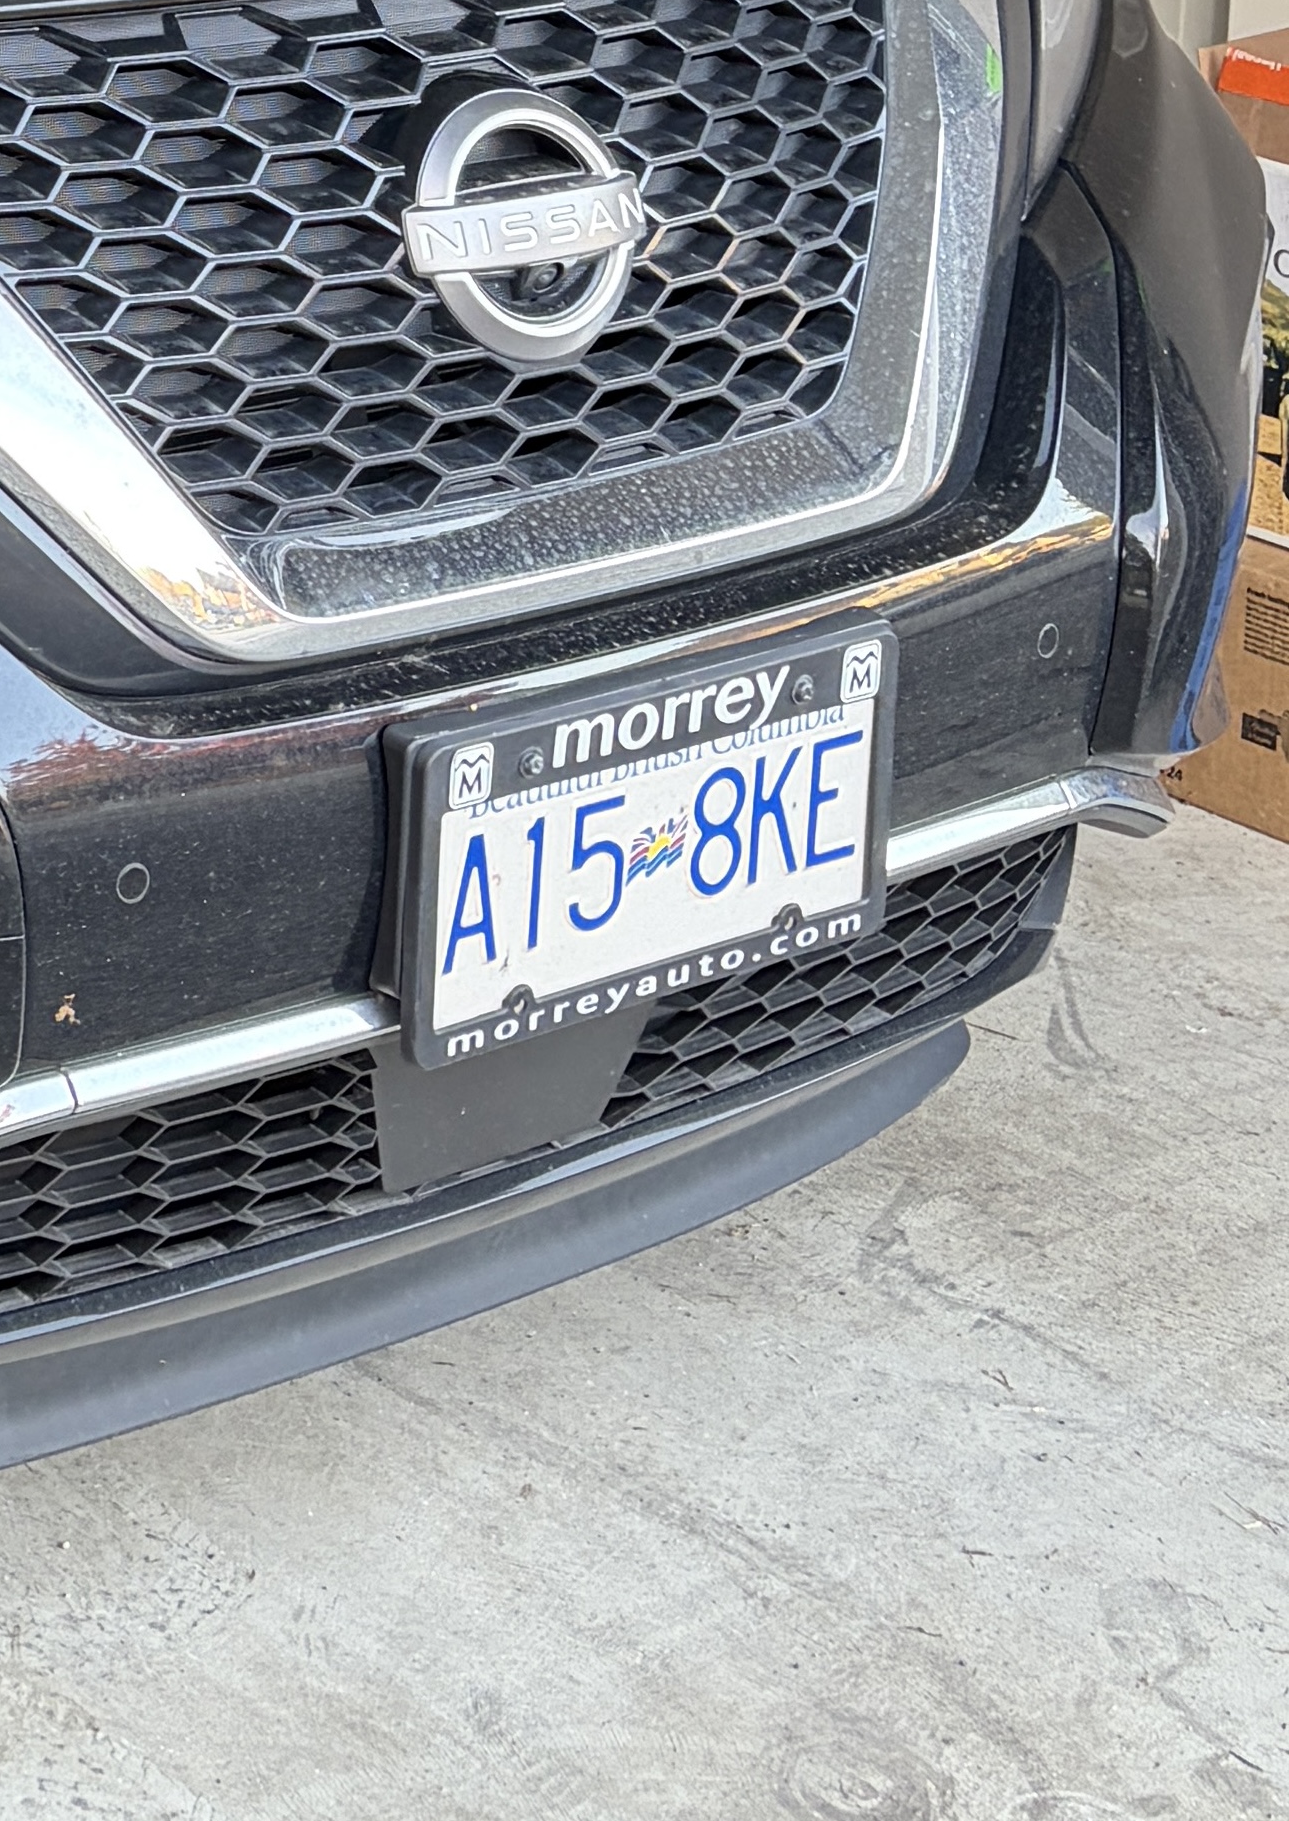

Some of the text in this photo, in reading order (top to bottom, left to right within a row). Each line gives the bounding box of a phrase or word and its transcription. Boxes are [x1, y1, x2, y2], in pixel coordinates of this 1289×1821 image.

[416, 187, 646, 262] NISSAN
[551, 664, 791, 769] morrey
[441, 730, 864, 975] A15 8KE
[445, 911, 862, 1057] morreyauto.com
